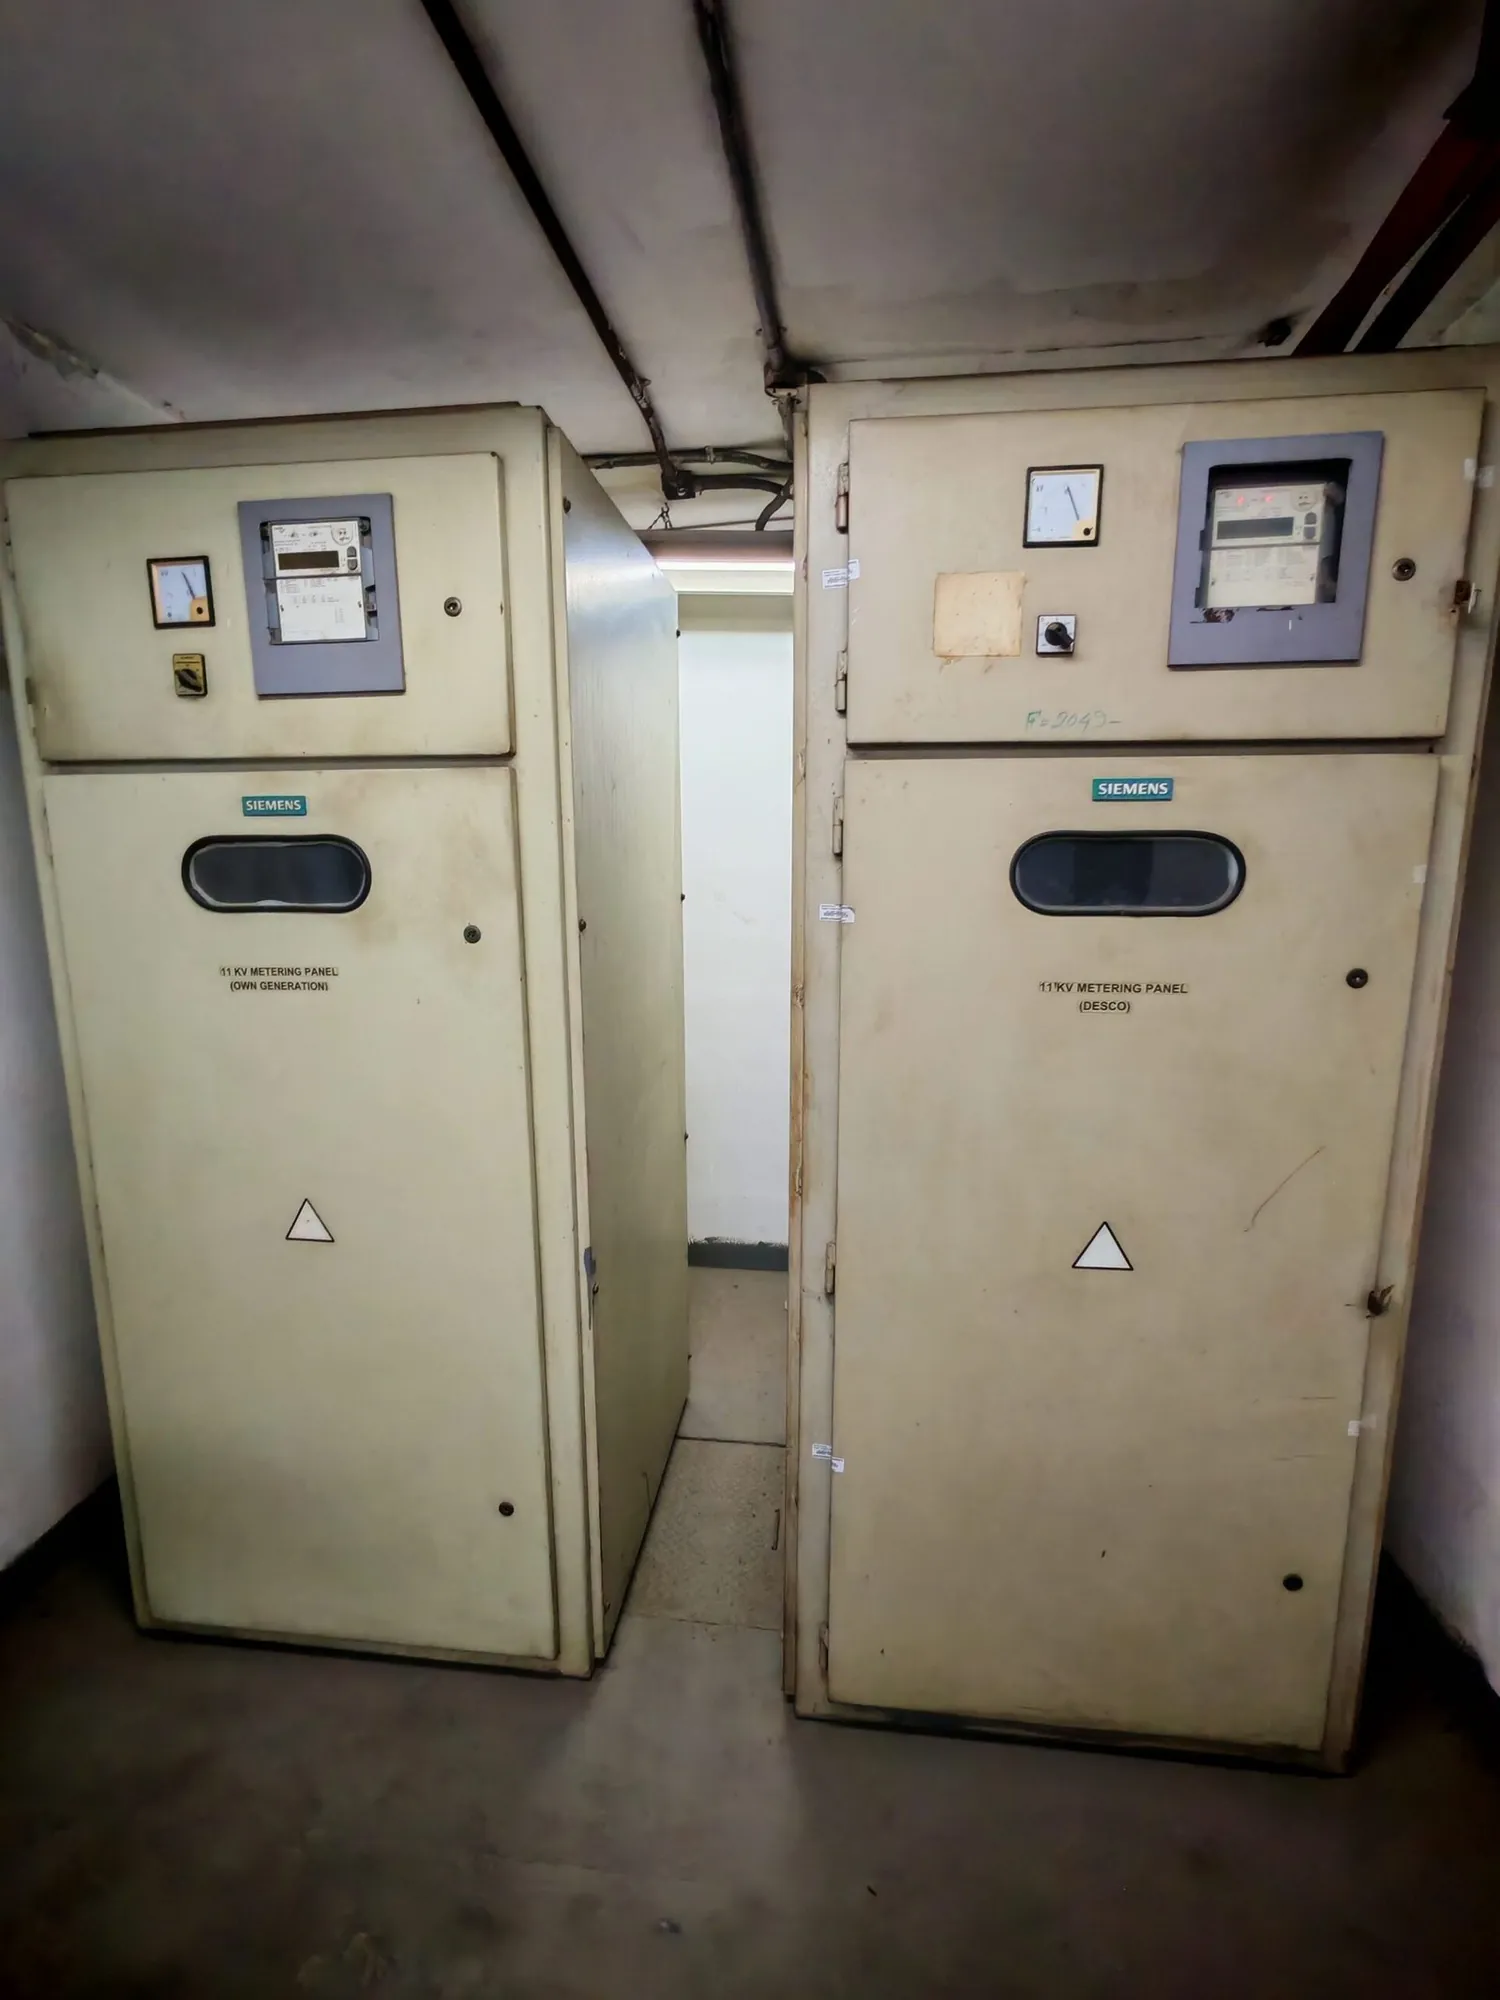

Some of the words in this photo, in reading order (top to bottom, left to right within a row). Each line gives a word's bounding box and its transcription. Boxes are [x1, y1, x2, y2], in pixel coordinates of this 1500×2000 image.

[1097, 783, 1169, 795] SIEMENS
[243, 800, 302, 811] SIEMENS
[220, 967, 231, 976] 11
[234, 967, 248, 976] KV
[250, 967, 302, 976] METERING
[304, 967, 338, 976] PANEL
[230, 981, 257, 991] (OWN
[260, 981, 329, 991] GENERATION)
[1077, 983, 1142, 993] METERING
[1145, 984, 1189, 993] PANEL
[1079, 1001, 1131, 1013] (DESCO)
